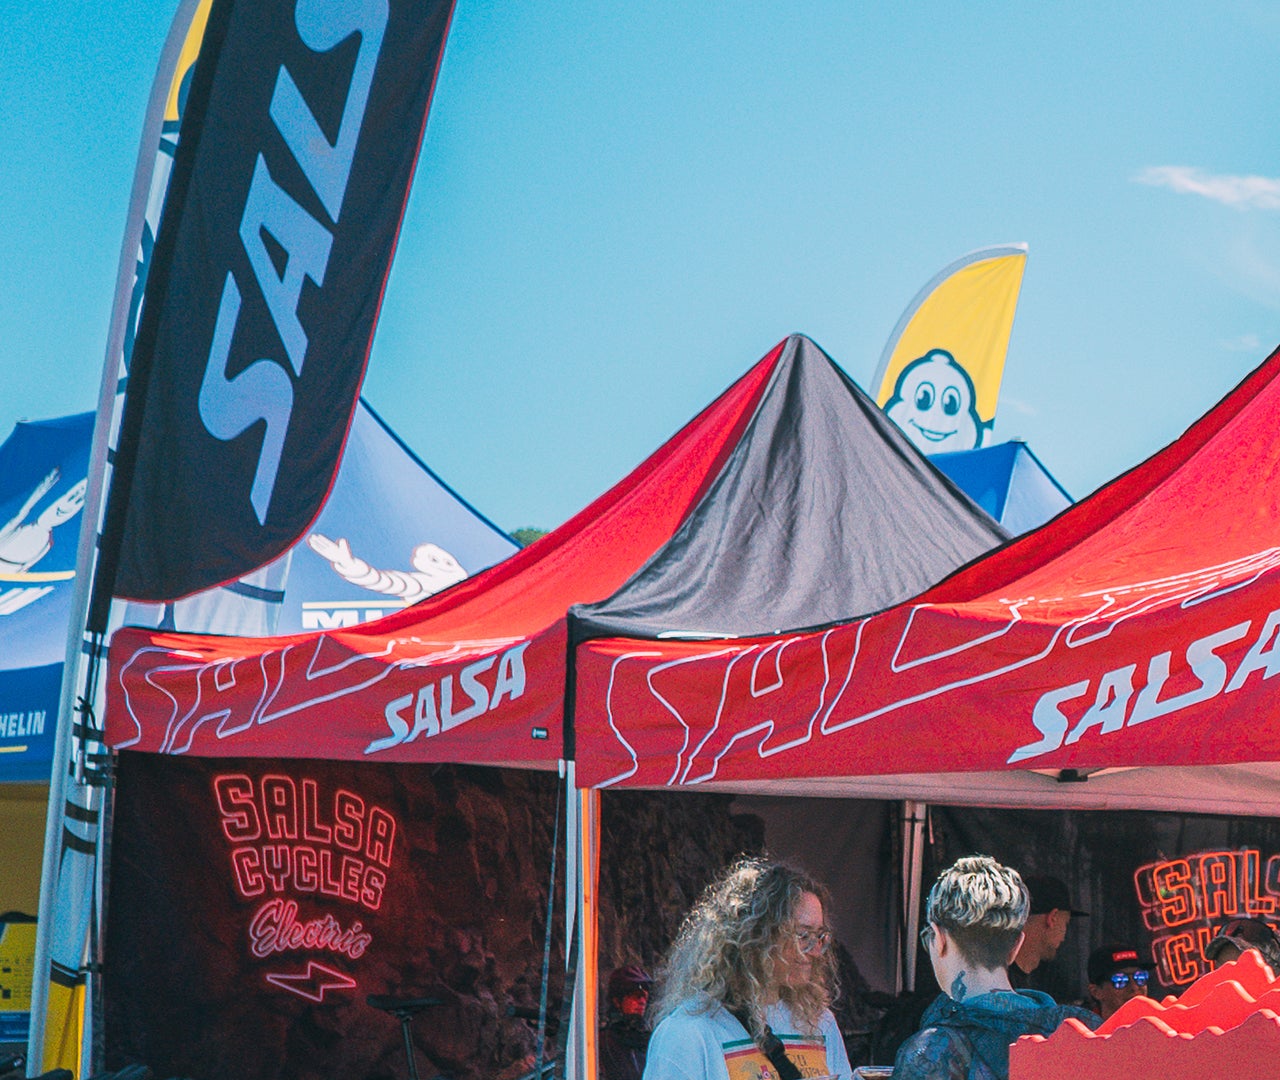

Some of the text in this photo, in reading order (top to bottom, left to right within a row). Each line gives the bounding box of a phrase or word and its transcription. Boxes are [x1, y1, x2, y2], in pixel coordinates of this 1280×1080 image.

[365, 642, 532, 756] SALSA
[212, 773, 399, 869] SALSA
[231, 844, 389, 911] CYCLES
[247, 897, 373, 960] Electric
